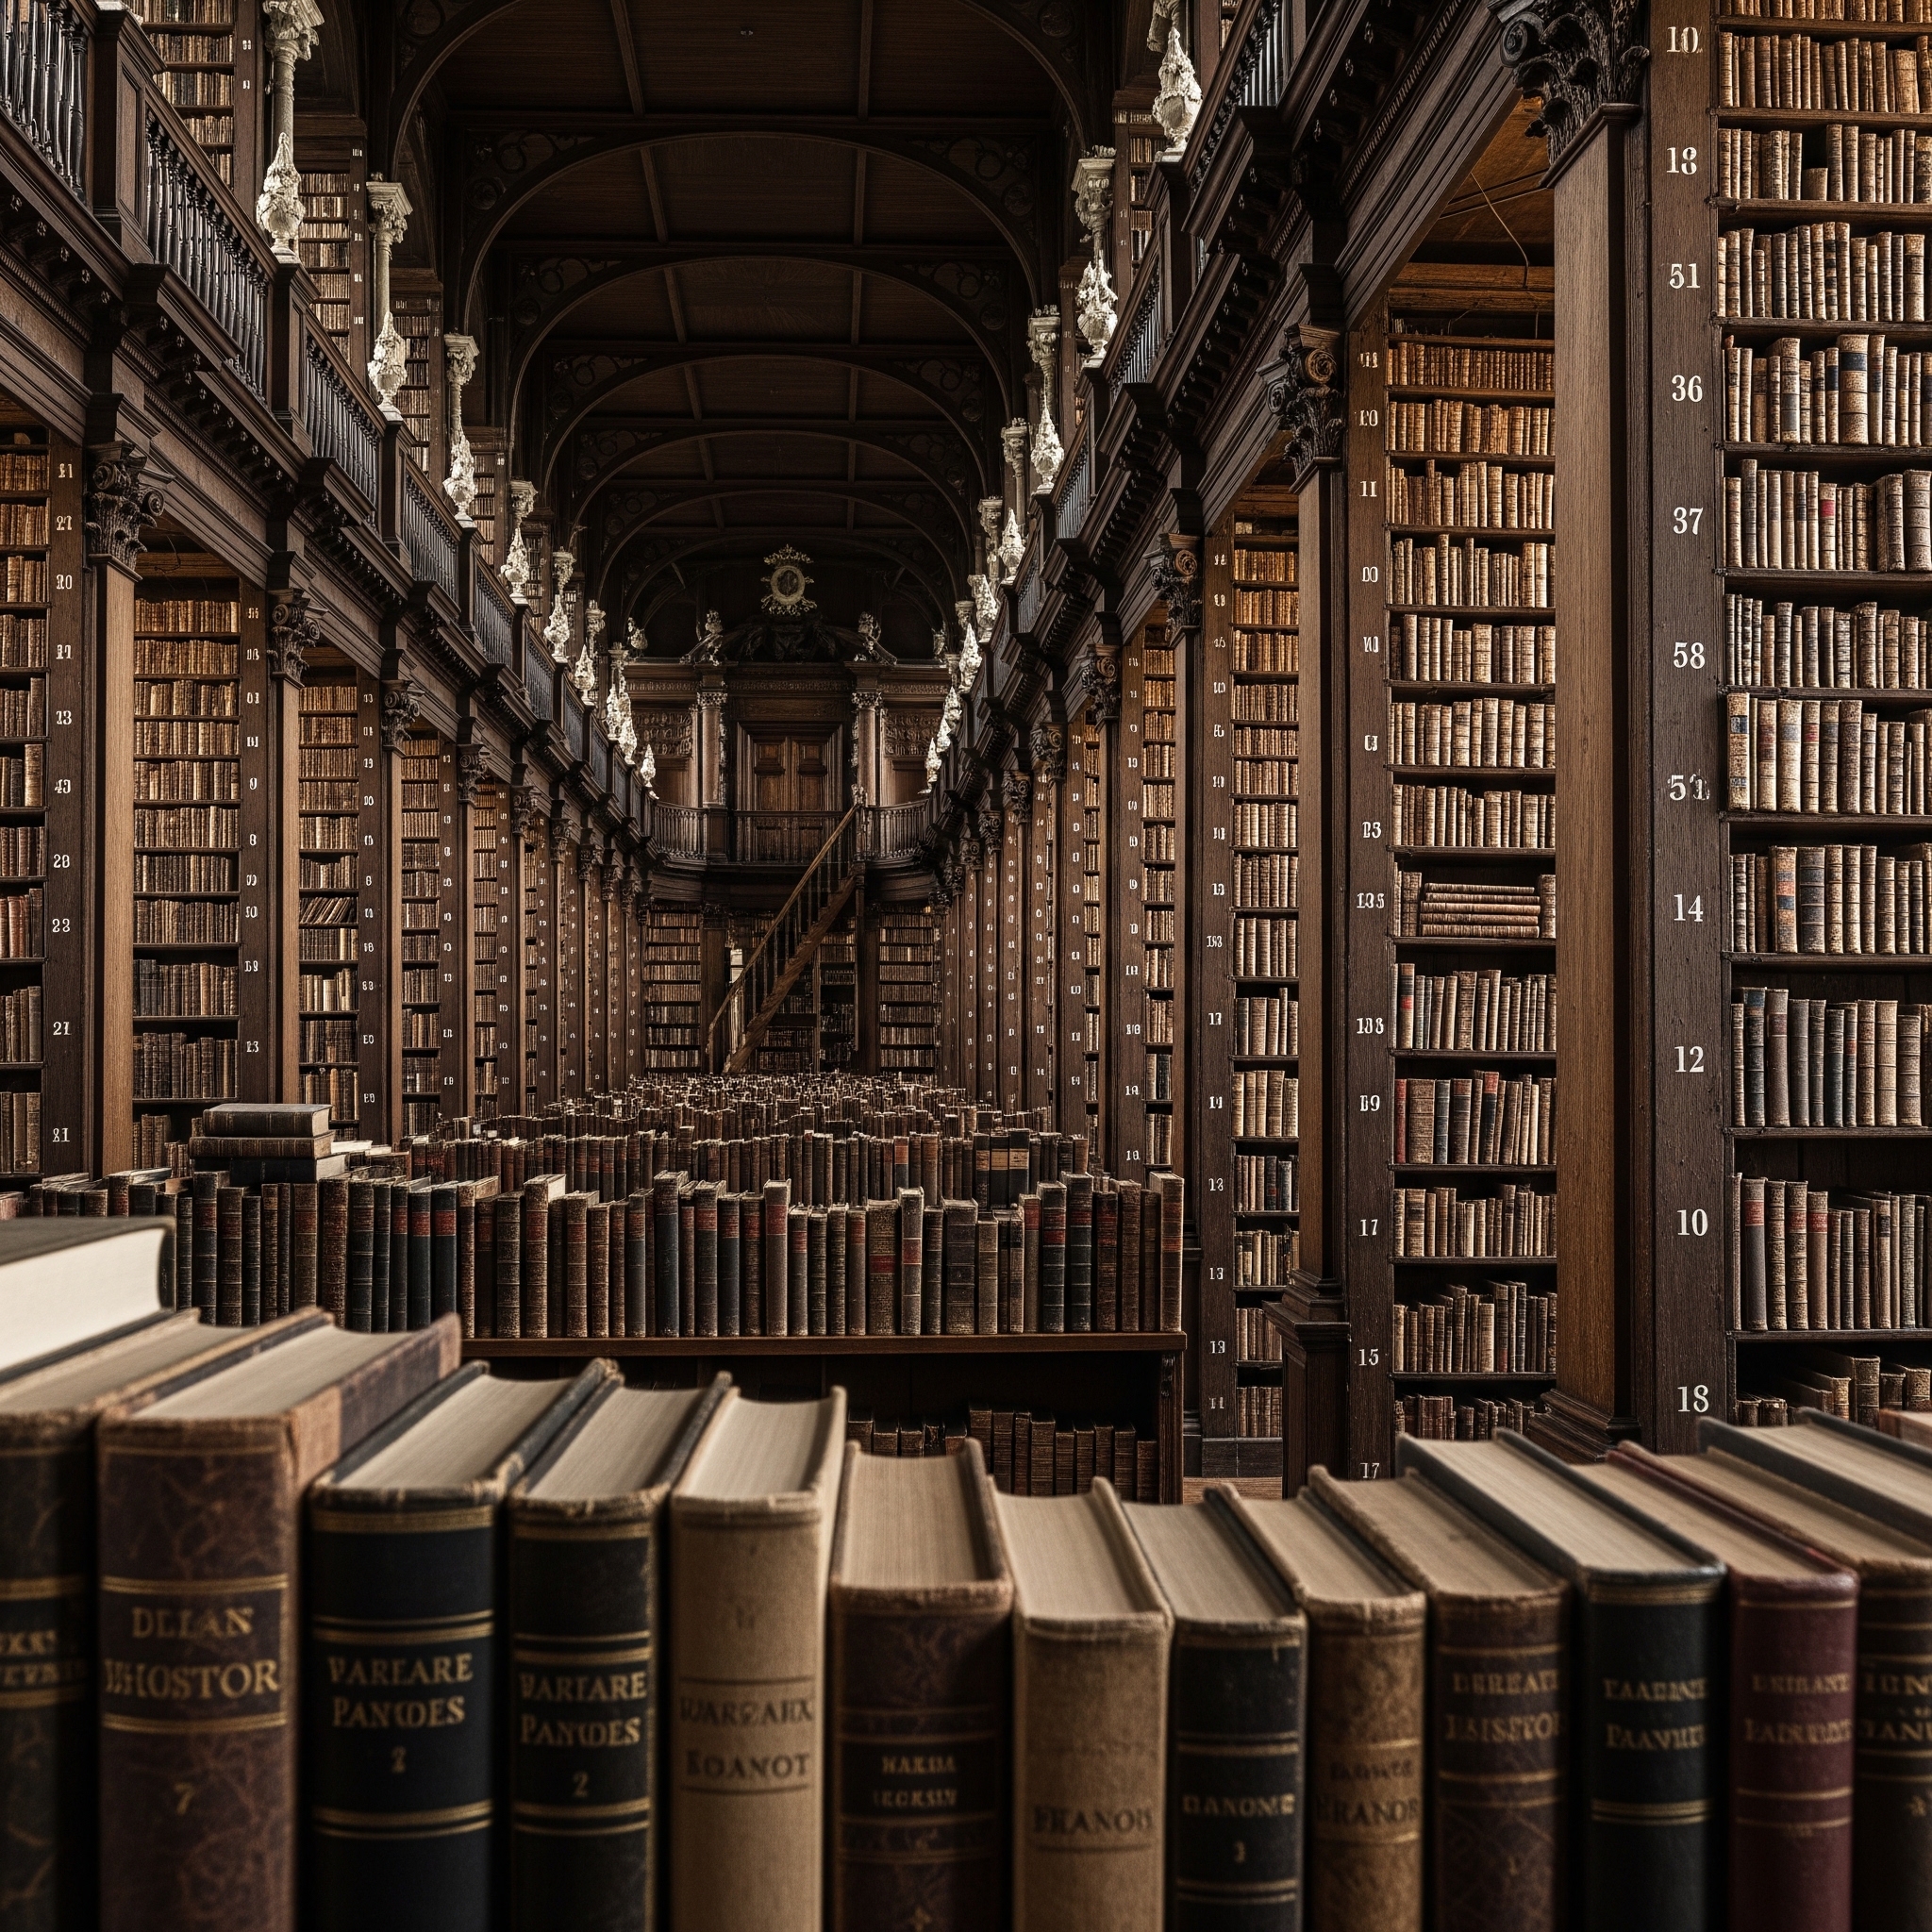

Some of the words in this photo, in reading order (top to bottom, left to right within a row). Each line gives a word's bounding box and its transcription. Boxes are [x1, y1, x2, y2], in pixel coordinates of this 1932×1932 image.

[1669, 262, 1701, 290] 51
[1671, 375, 1703, 403] 36
[1673, 507, 1704, 535] 37
[1673, 641, 1706, 670] 58
[1674, 893, 1704, 923] 14
[1674, 1045, 1705, 1073] 12
[1357, 1218, 1379, 1238] 17
[1676, 1208, 1708, 1237] 10
[1358, 1348, 1379, 1366] 15
[1677, 1384, 1709, 1414] 18
[1359, 1462, 1381, 1479] 17
[175, 1783, 193, 1814] 7
[573, 1771, 589, 1798] 2
